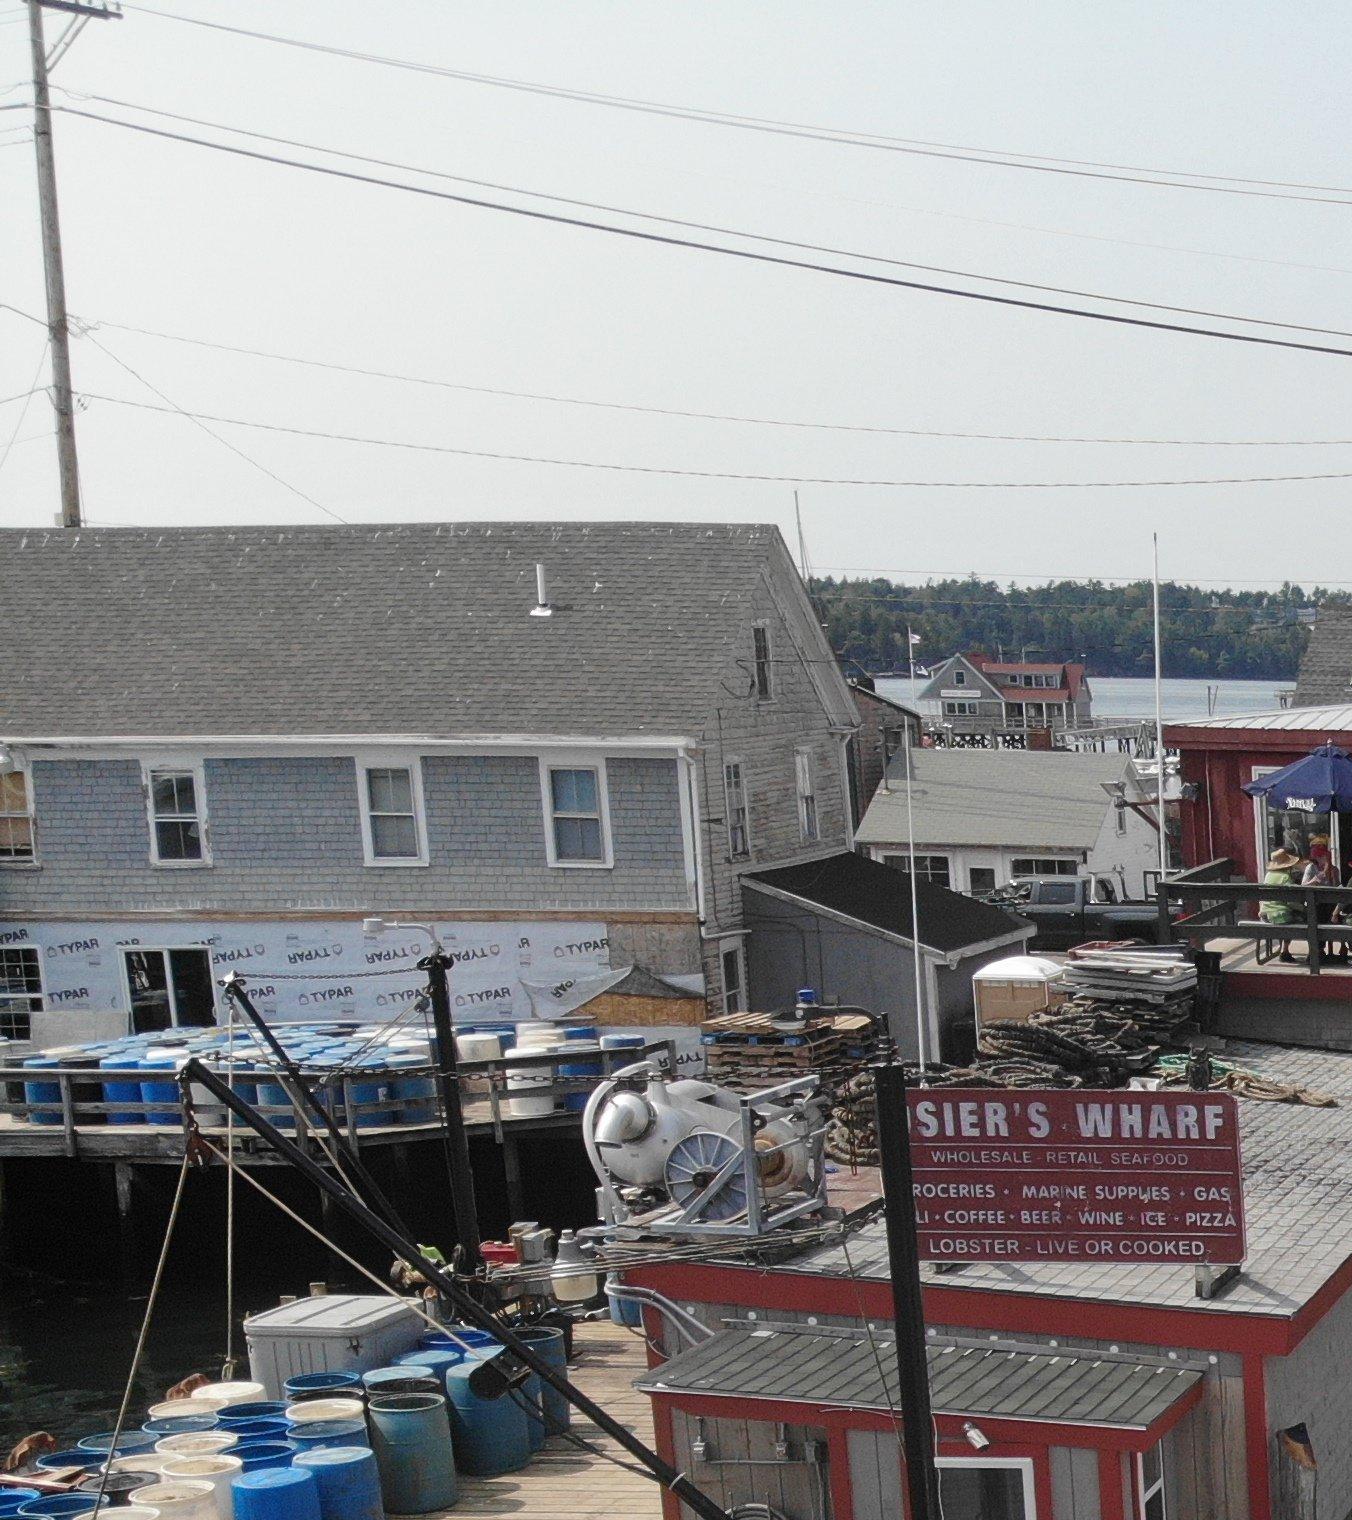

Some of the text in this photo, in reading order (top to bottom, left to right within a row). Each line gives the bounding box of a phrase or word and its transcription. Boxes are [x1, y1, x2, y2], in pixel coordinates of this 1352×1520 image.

[57, 937, 100, 956] TYPAR
[455, 946, 488, 963] TYPA
[567, 938, 610, 957] TYPAR
[288, 947, 330, 965] TYPAR
[365, 947, 409, 965] TYPAR
[49, 986, 89, 1003] TYPAR
[310, 986, 354, 1003] TYPAR
[389, 988, 424, 1001] TYPA
[467, 987, 511, 1004] TYPAR
[906, 1101, 1224, 1140] SIER'S WHARF
[931, 1150, 1189, 1166] WHOLESALE RETAIL SEAFOOD
[911, 1183, 1231, 1202] ROCERIES MARINE SUPPLIES GAS
[914, 1210, 1237, 1228] LI COFFEE BEER WINE ICE PIZZA
[929, 1238, 1206, 1256] LOBSTER LIVE OR COOKED
